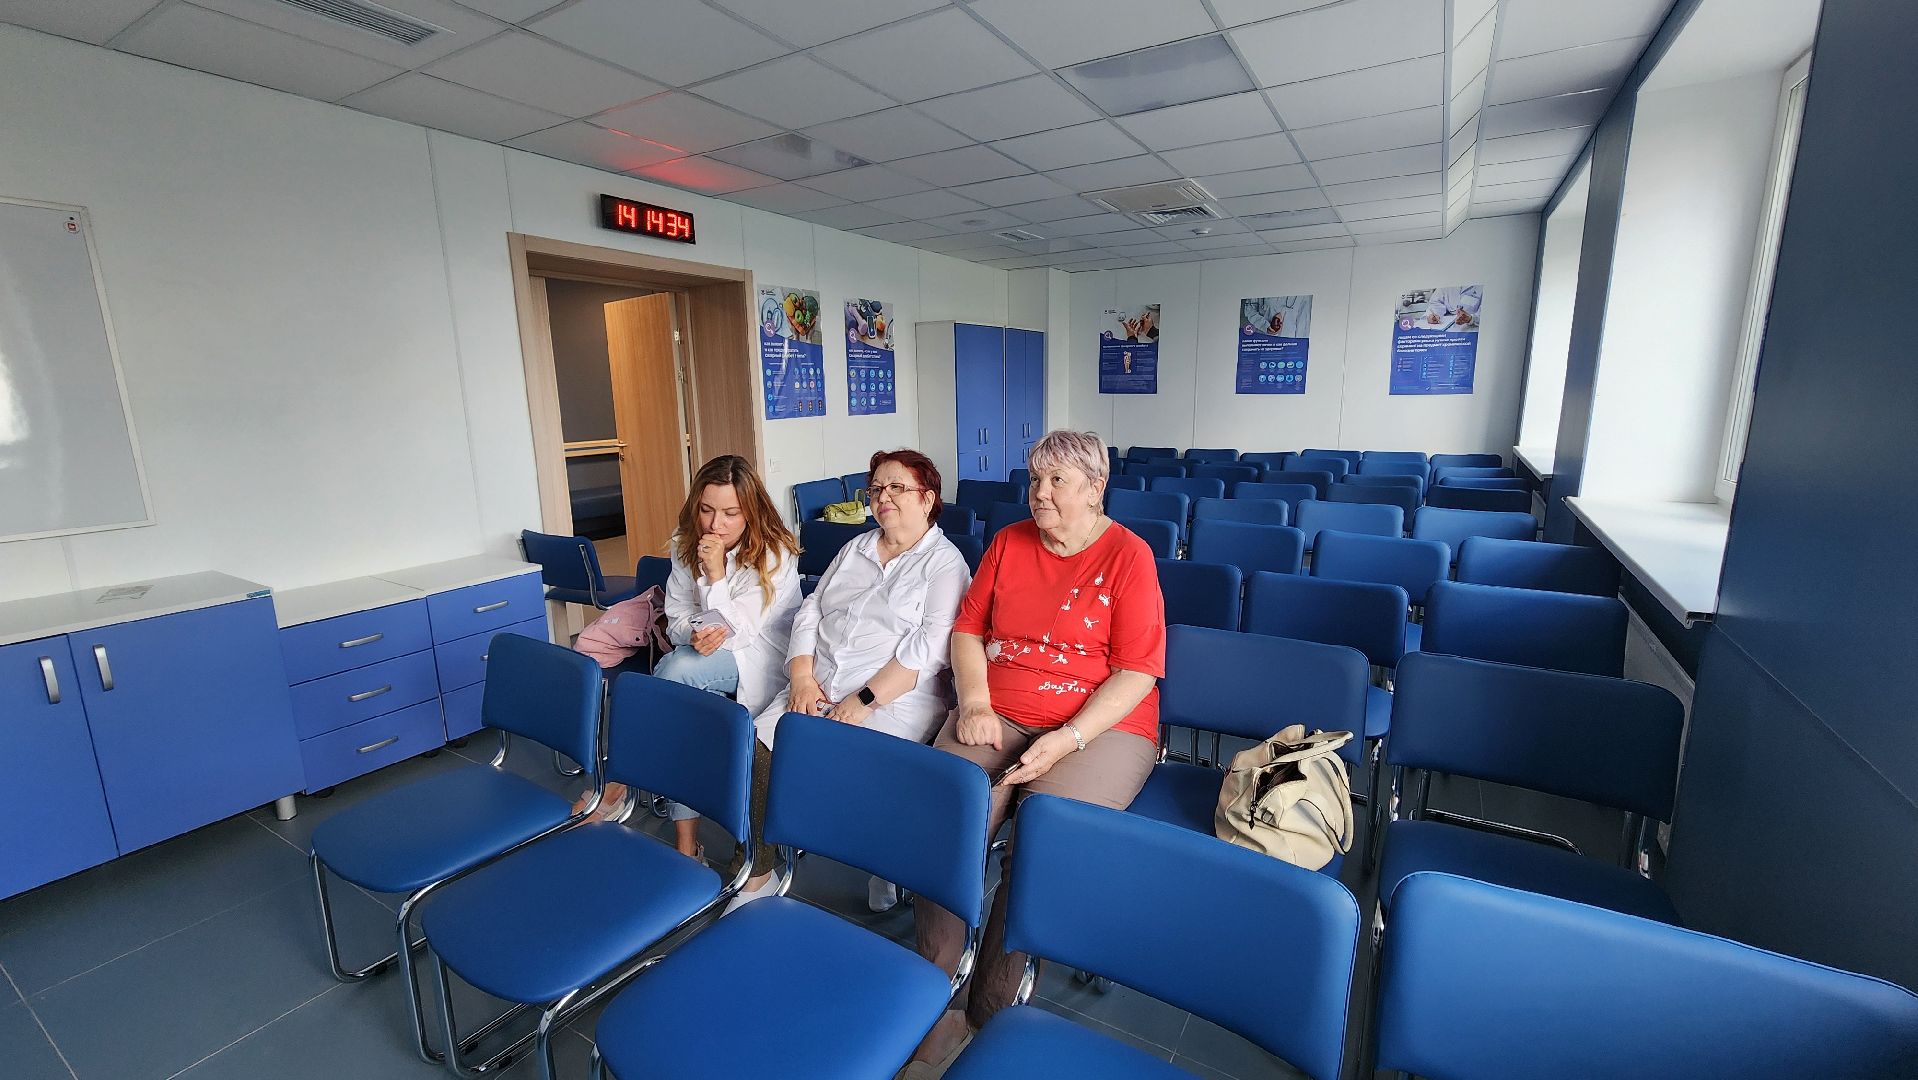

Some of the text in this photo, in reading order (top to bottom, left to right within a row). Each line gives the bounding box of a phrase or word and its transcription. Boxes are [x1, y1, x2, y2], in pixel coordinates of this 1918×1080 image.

[618, 204, 690, 238] 14 14 34
